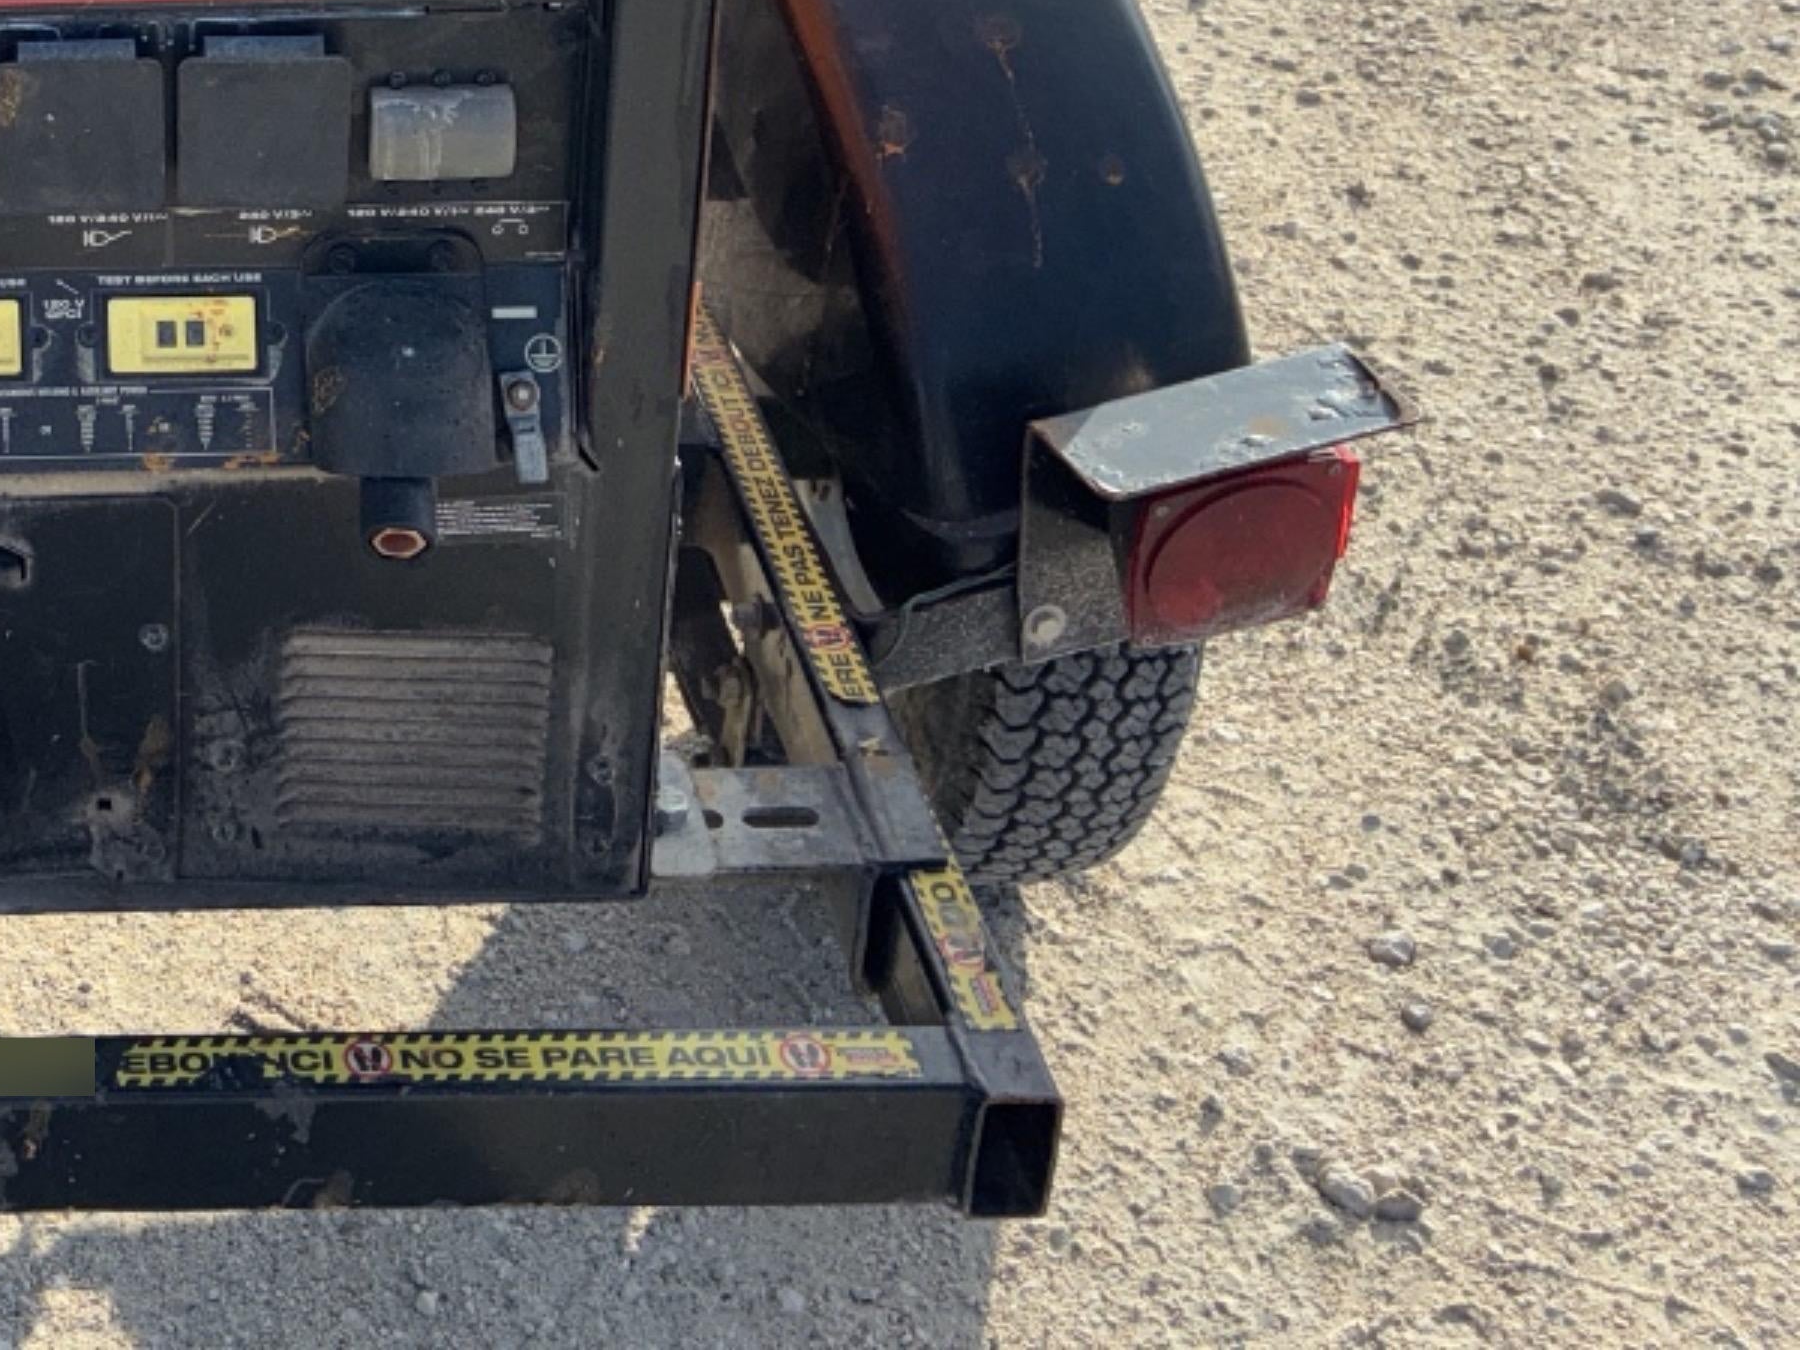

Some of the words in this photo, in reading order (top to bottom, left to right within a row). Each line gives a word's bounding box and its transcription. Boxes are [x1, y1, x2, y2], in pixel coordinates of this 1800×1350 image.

[828, 652, 866, 698] ERE
[401, 1047, 464, 1071] NO
[474, 1047, 531, 1070] SE
[542, 1045, 657, 1069] PARE
[666, 1040, 772, 1068] AQUÍ
